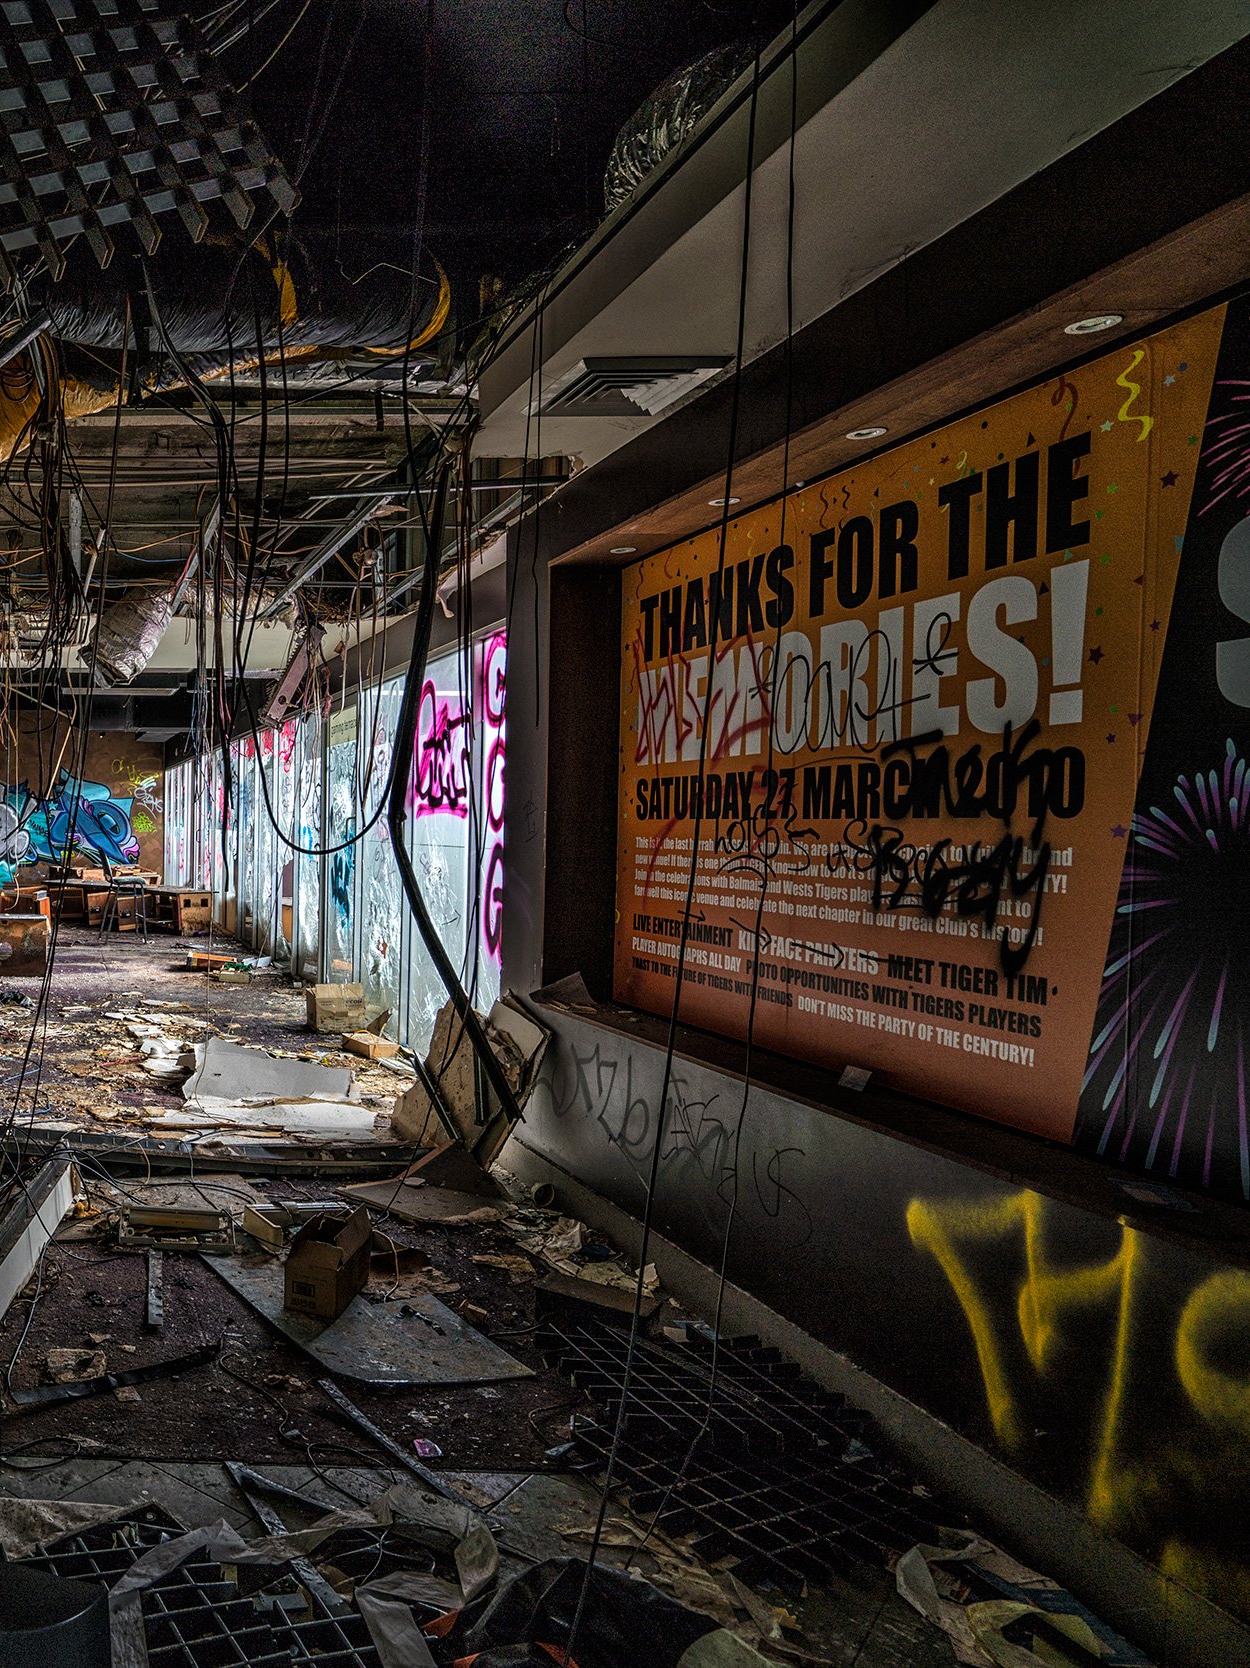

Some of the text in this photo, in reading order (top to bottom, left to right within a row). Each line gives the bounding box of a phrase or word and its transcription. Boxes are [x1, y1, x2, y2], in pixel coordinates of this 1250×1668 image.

[639, 431, 1091, 663] THANKS FOR THE
[636, 559, 1090, 766] MEMORIES!
[634, 768, 756, 821] SATURDAY
[759, 766, 796, 821] 27
[635, 836, 649, 849] This
[649, 837, 656, 850] is
[663, 837, 674, 850] the
[675, 837, 689, 851] last
[793, 841, 809, 856] We
[810, 843, 828, 857] are
[950, 845, 963, 862] to
[635, 854, 648, 865] new
[670, 854, 676, 867] If
[697, 856, 704, 869] is
[704, 858, 718, 870] one
[771, 860, 796, 875] know
[820, 863, 830, 878] to
[634, 868, 647, 881] Join
[655, 870, 666, 882] the
[710, 873, 728, 889] with
[783, 880, 814, 899] Wests
[814, 882, 849, 902] Tigers
[1014, 899, 1032, 918] to
[660, 886, 674, 900] this
[696, 891, 718, 907] venue
[719, 892, 735, 908] and
[777, 899, 794, 915] the
[795, 901, 817, 918] next
[818, 903, 861, 923] chapter
[862, 908, 873, 925] in
[875, 912, 897, 928] our
[898, 913, 934, 934] great
[935, 916, 979, 939] Club's
[632, 936, 657, 955] PLAYER
[708, 951, 723, 970] ALL
[723, 954, 742, 973] DAY
[780, 965, 869, 1001] OPPORTUNITIES
[872, 984, 908, 1010] WITH
[911, 992, 965, 1022] TIGERS
[968, 1002, 1041, 1038] PLAYERS
[633, 912, 651, 932] LIVE
[769, 934, 803, 961] FACE
[805, 940, 879, 976] PAINTERS
[887, 953, 934, 985] MEET
[938, 961, 999, 997] TIGER
[1004, 973, 1048, 1006] TIM
[632, 956, 650, 972] TOAST
[651, 959, 659, 974] TO
[660, 961, 672, 977] THE
[697, 971, 707, 986] OF
[707, 973, 734, 992] TIGERS
[757, 985, 793, 1007] FRIENDS
[797, 995, 826, 1016] DON'T
[827, 1002, 854, 1023] MISS
[855, 1008, 877, 1028] THE
[878, 1013, 916, 1038] PARTY
[917, 1022, 934, 1043] OF
[935, 1027, 961, 1050] THE
[963, 1033, 1036, 1068] CENTURY!
